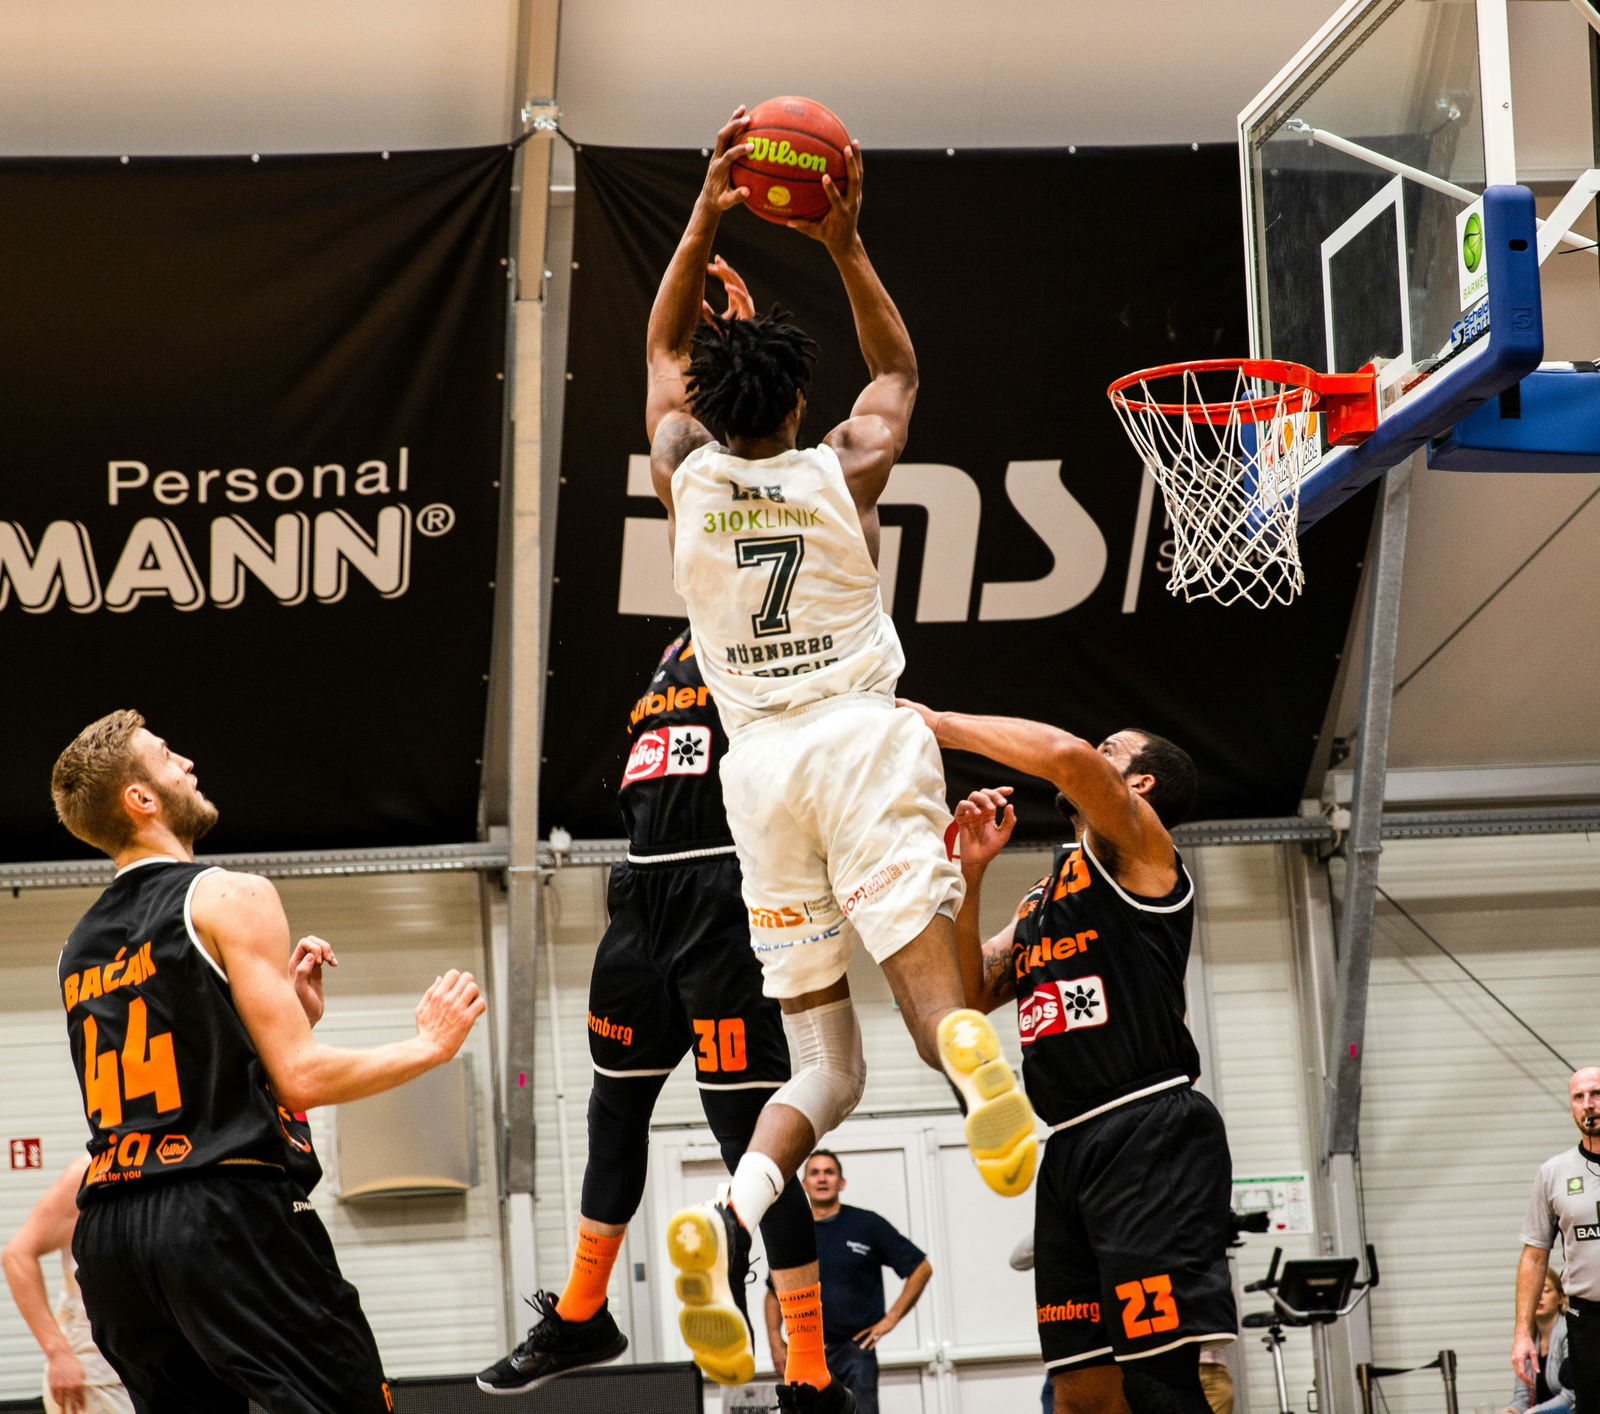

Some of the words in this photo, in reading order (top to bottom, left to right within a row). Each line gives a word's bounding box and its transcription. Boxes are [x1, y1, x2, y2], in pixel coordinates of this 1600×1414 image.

[747, 136, 827, 173] Wilson
[108, 447, 408, 505] Personal
[734, 534, 804, 638] 7
[726, 634, 833, 664] NÜRNBERG
[64, 941, 157, 1013] BAĆAK
[83, 996, 182, 1129] 44
[692, 1017, 748, 1072] 30
[123, 1169, 141, 1182] you
[1115, 1274, 1180, 1339] 23
